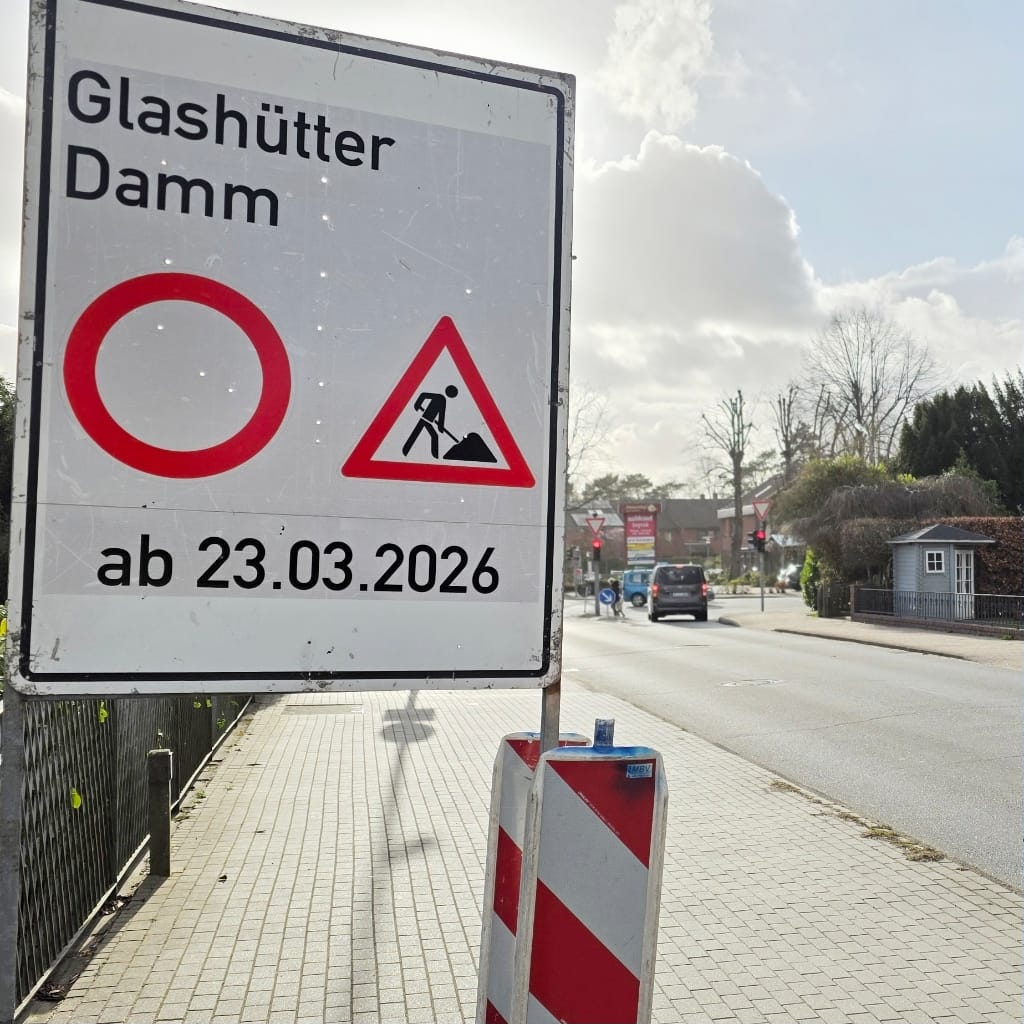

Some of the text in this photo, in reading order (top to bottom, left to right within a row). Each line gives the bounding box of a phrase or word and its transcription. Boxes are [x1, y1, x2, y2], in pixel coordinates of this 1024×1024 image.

[67, 69, 396, 171] Glashütter
[65, 144, 279, 227] Damm
[96, 533, 500, 595] ab 23.03.2026
